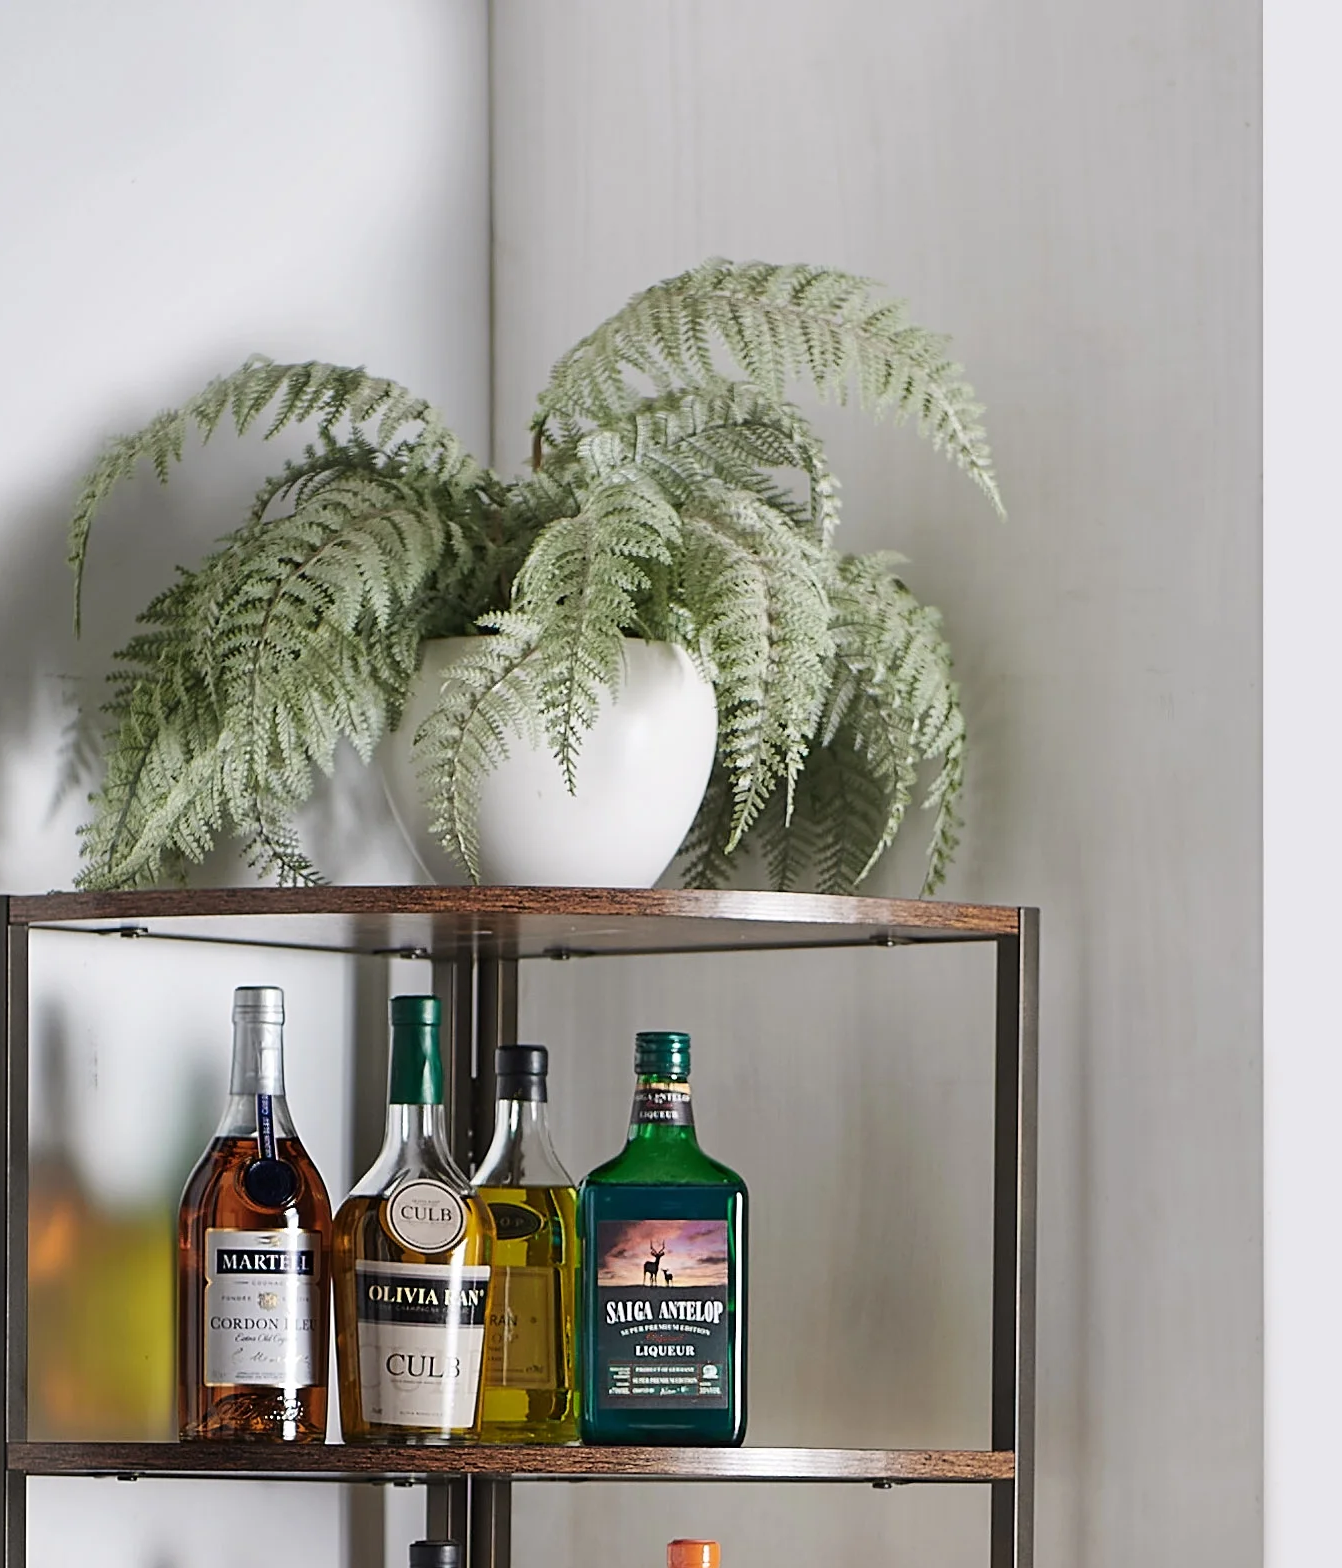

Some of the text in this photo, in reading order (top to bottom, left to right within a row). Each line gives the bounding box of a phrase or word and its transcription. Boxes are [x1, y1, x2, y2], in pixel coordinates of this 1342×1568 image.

[400, 1204, 453, 1222] CULB
[368, 1284, 439, 1306] OLIVIA
[606, 1300, 724, 1325] SAIGA ANTELOP
[210, 1316, 279, 1331] CORDON
[635, 1345, 696, 1358] LIQUEUR
[385, 1353, 460, 1379] CULB
